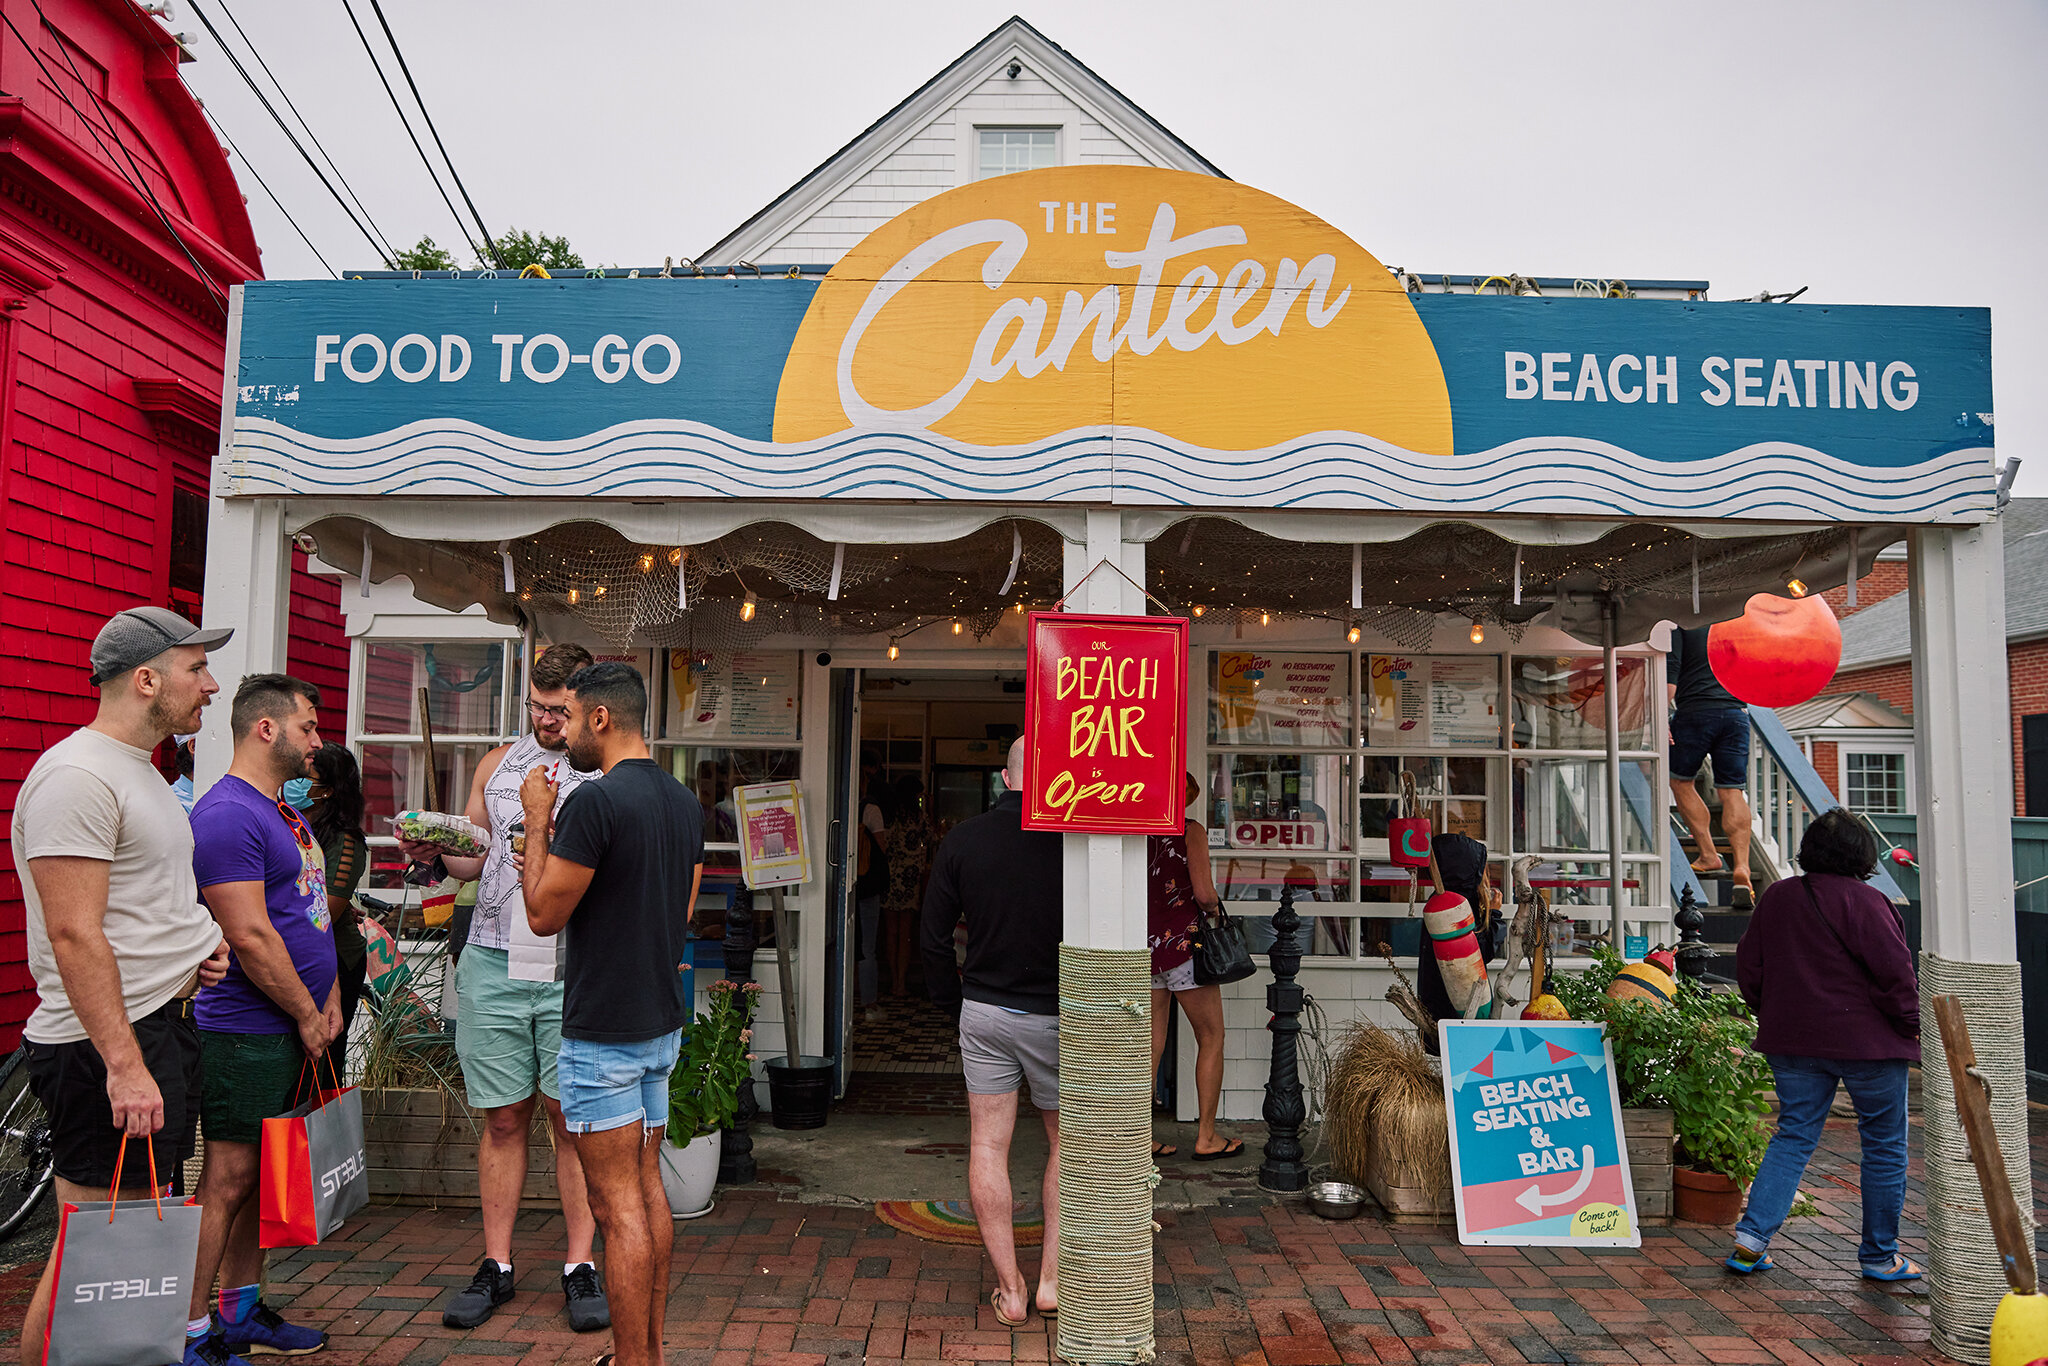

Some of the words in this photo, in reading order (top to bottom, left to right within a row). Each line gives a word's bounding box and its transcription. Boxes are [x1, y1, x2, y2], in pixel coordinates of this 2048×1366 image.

[1039, 201, 1117, 234] THE
[836, 202, 1352, 430] Canteen
[314, 333, 472, 383] FOOD
[492, 333, 682, 384] TO-GO
[1505, 351, 1678, 404] BEACH
[1700, 355, 1919, 411] SEATING
[1091, 640, 1112, 651] OUR
[1056, 655, 1159, 700] BEACH
[1221, 654, 1273, 678] Canteen
[1286, 673, 1306, 682] BEACH
[1292, 662, 1336, 671] RESERVATIONS
[1371, 656, 1413, 679] Canteen
[1069, 704, 1154, 758] BAR
[1092, 767, 1103, 778] is
[1045, 770, 1146, 822] Open
[1236, 823, 1315, 845] OPEN
[1479, 1073, 1574, 1107] BEACH
[1472, 1096, 1592, 1132] SEATING
[1529, 1126, 1555, 1149] &
[1517, 1147, 1580, 1176] BAR
[1578, 1211, 1606, 1223] Come
[1607, 1209, 1619, 1218] on
[1589, 1218, 1617, 1235] back!
